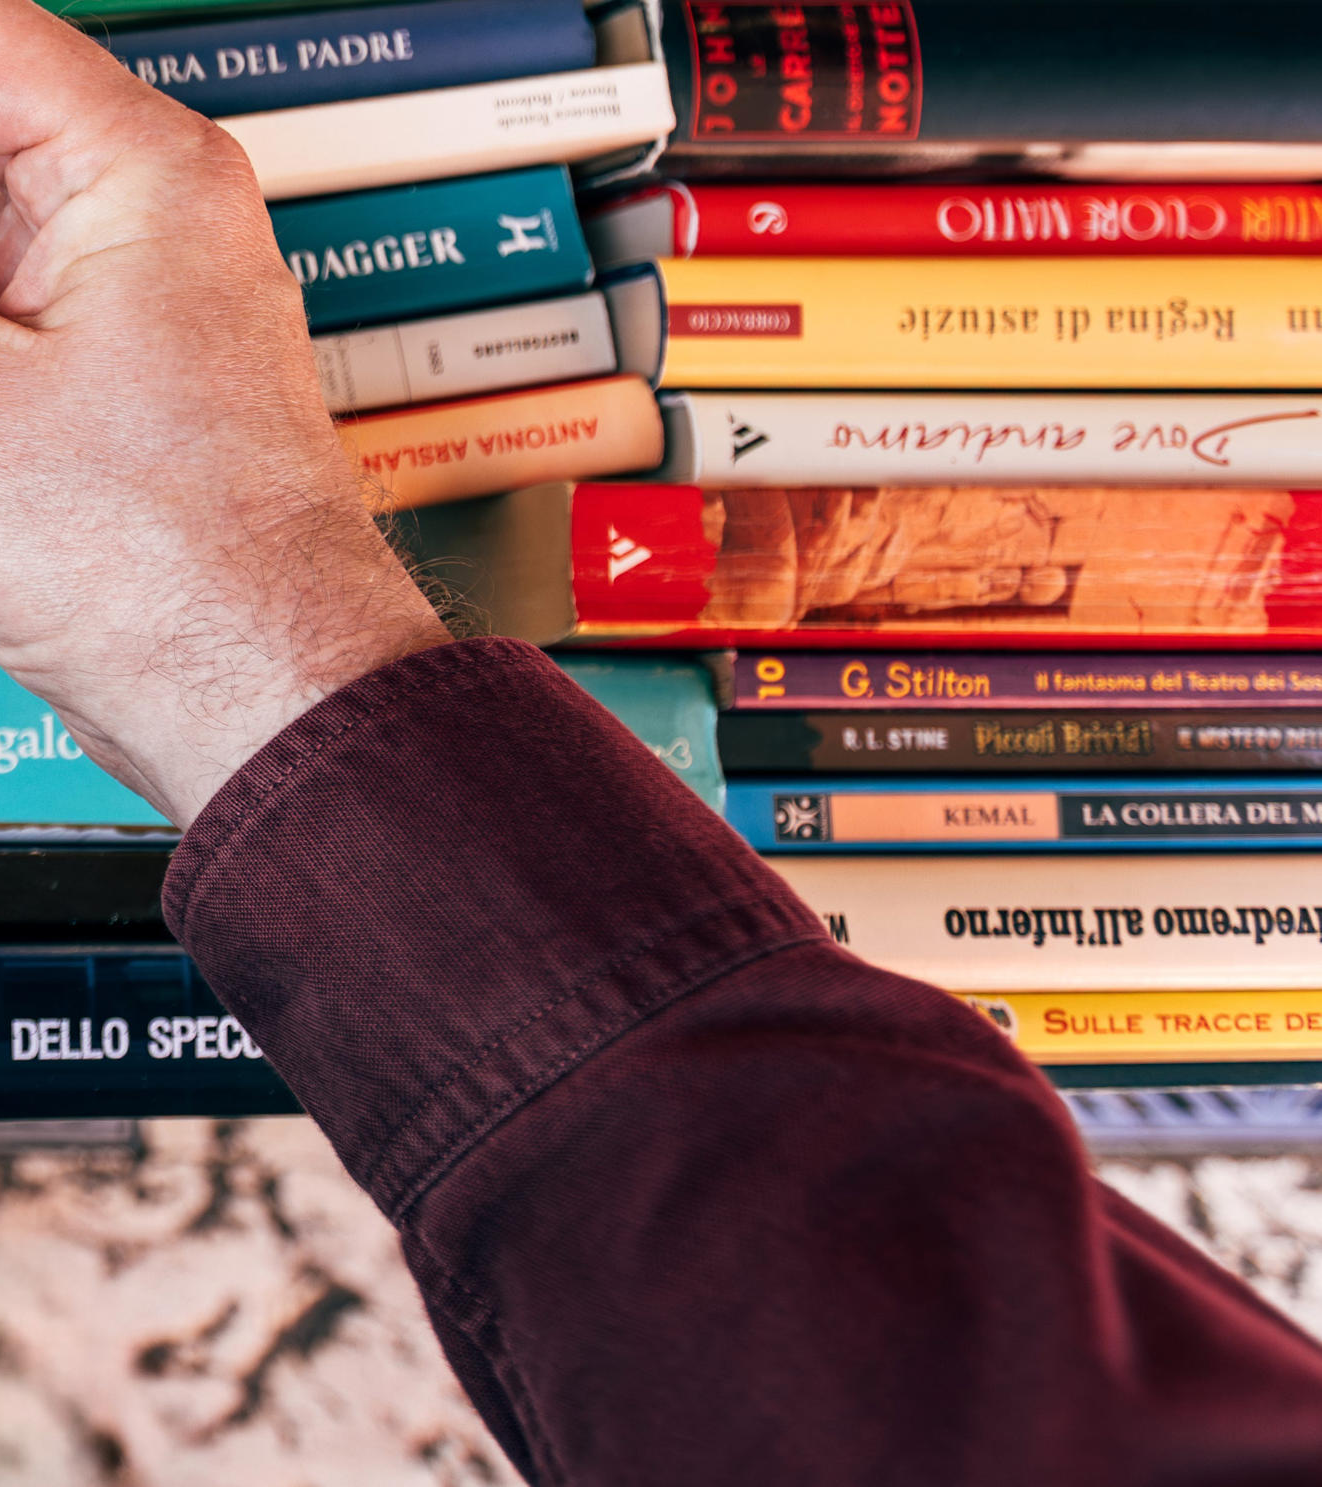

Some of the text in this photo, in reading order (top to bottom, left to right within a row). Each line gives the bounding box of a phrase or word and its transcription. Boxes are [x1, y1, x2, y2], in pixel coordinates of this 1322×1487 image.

[215, 42, 288, 80] DEL
[296, 27, 414, 74] PADRE
[1078, 194, 1229, 243] CUORE
[288, 224, 468, 289] DAGGER
[687, 311, 793, 331] CORBACCIO
[899, 296, 1238, 342] Regina di astuzie
[478, 415, 601, 459] ANTONIA
[825, 409, 1320, 466] Dove andiamo
[755, 658, 786, 699] 10
[884, 661, 991, 698] Stilton
[1053, 669, 1249, 694] fantasma del Teatro
[887, 726, 950, 752] STINE
[973, 720, 1054, 756] Piccoli
[942, 805, 1037, 829] KEMAL
[1080, 803, 1291, 829] LA COLLERA DEL
[944, 906, 1145, 948] all'inferno
[11, 1016, 130, 1061] DELLO
[1154, 1009, 1274, 1036] TRACCE
